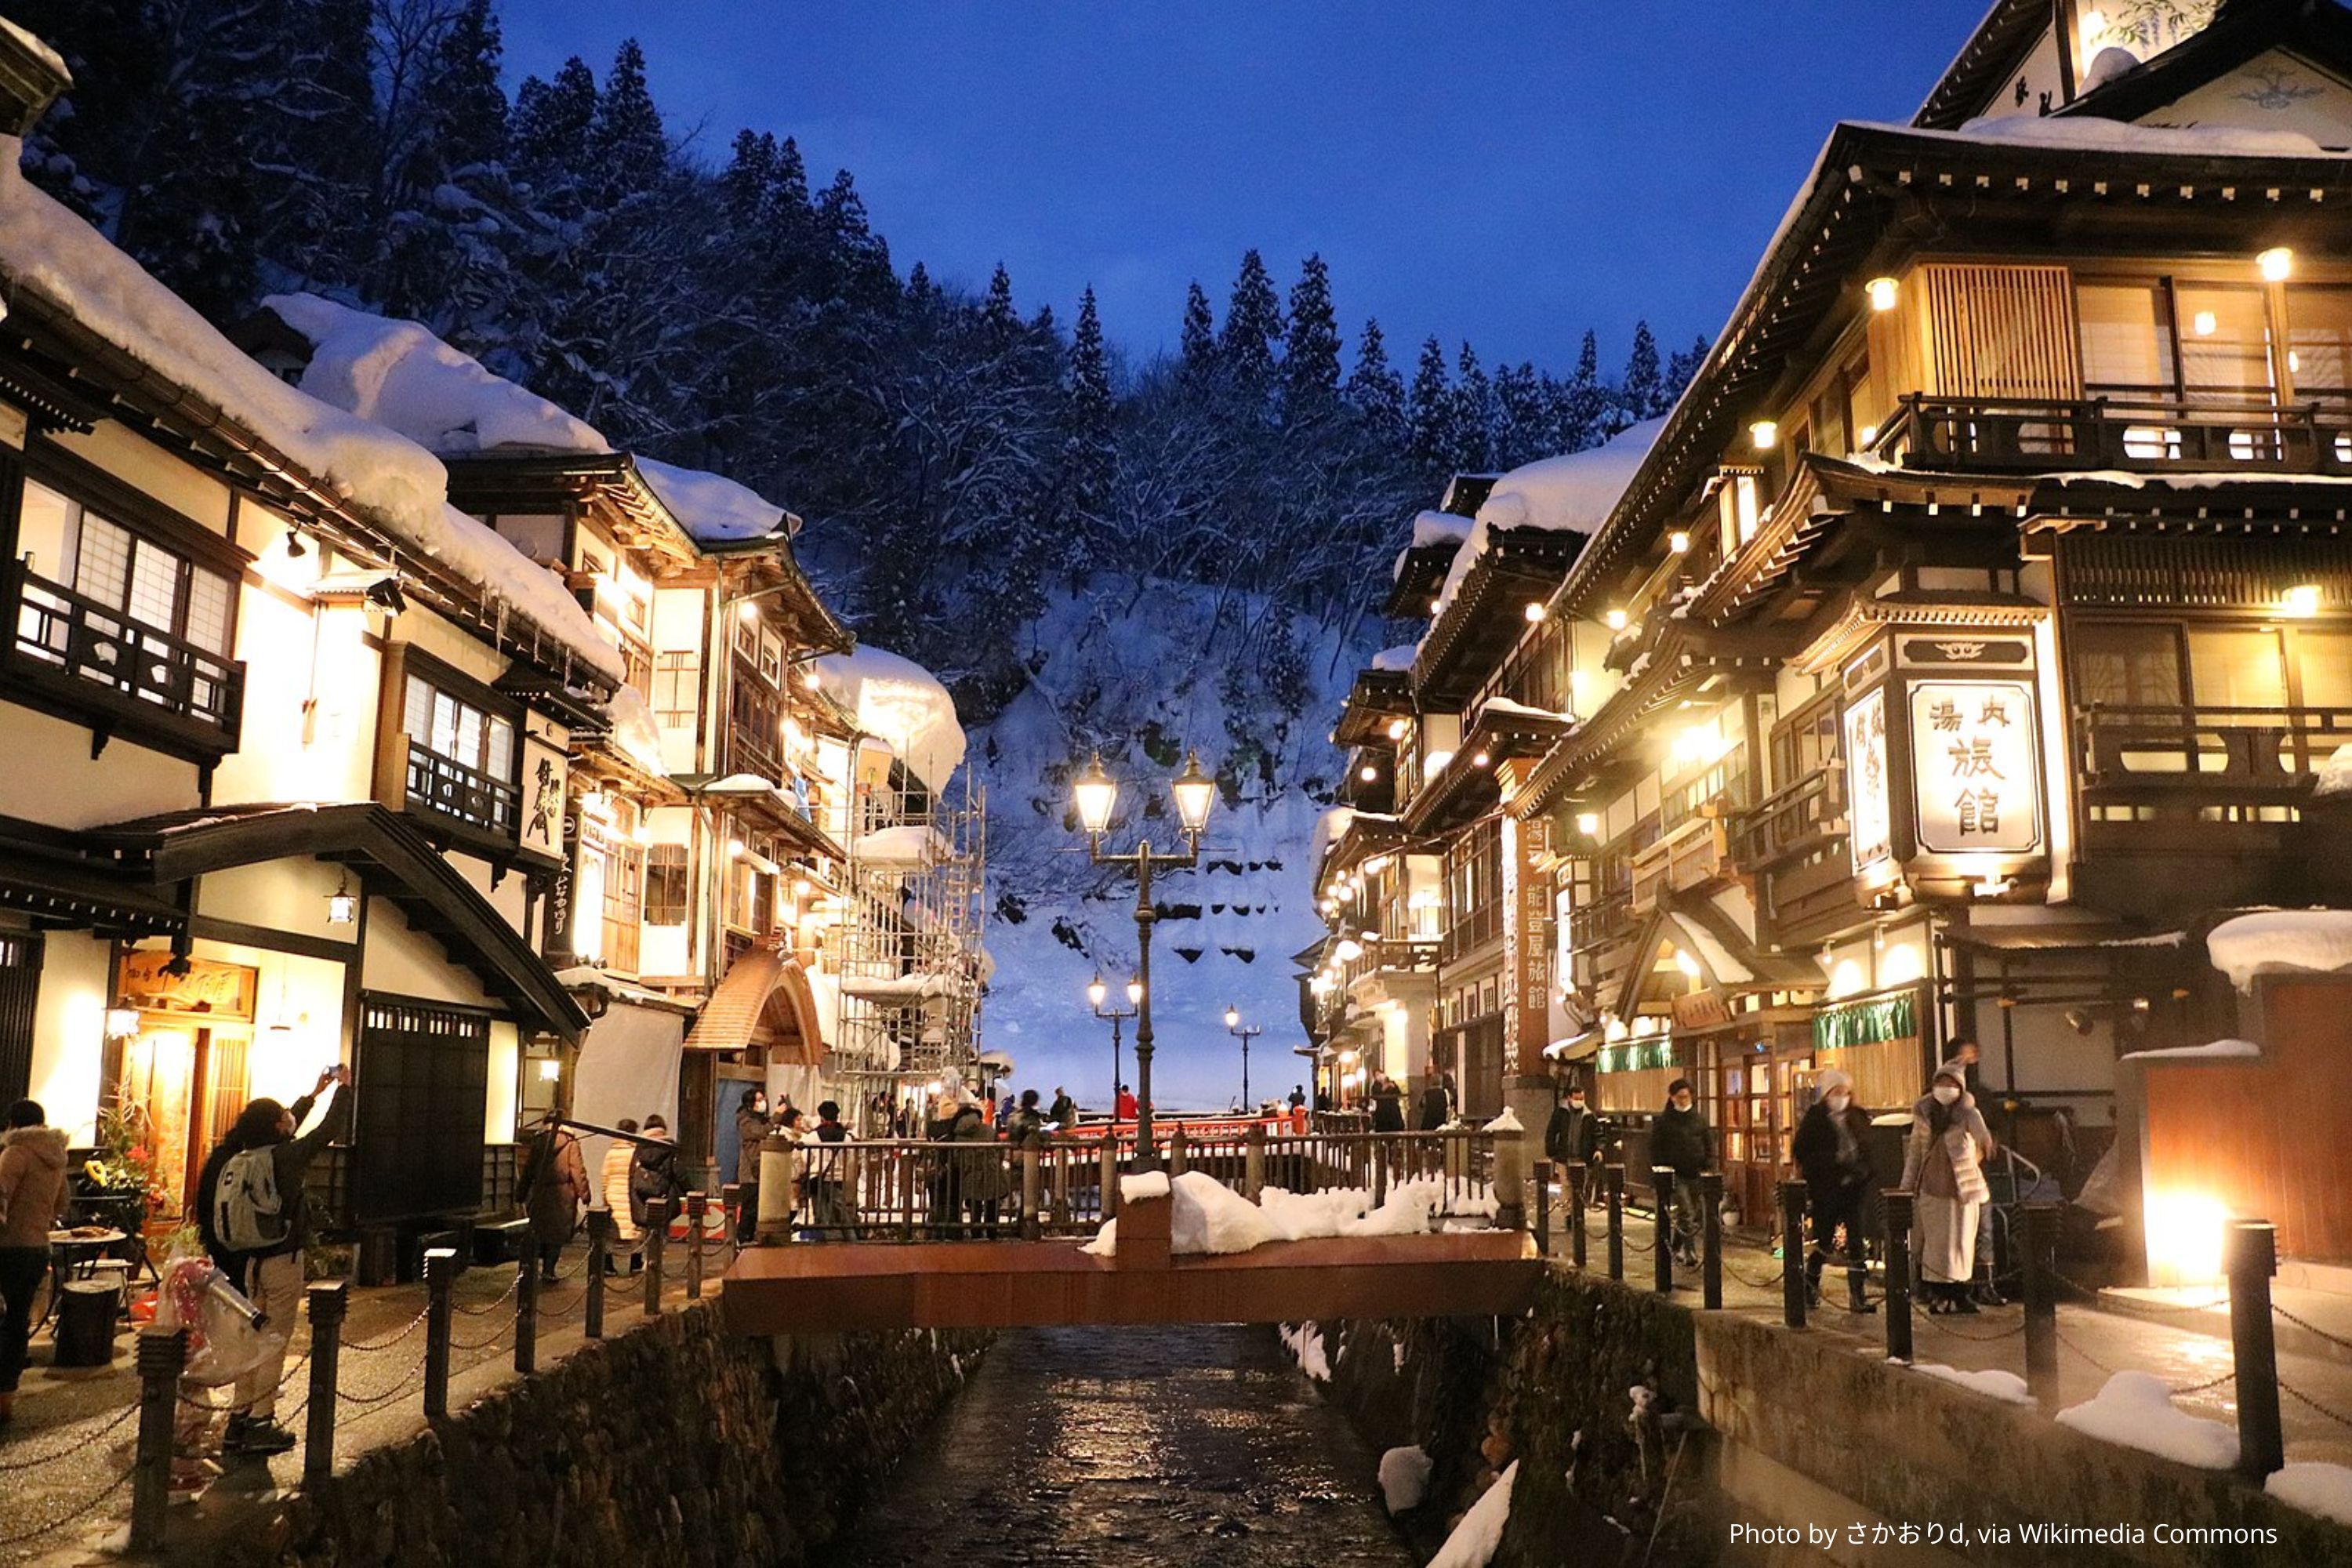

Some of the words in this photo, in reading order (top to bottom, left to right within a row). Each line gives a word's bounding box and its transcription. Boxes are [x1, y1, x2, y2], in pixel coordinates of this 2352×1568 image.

[1948, 735, 2006, 837] 旅館
[1526, 884, 1545, 1010] 能登屋旅館
